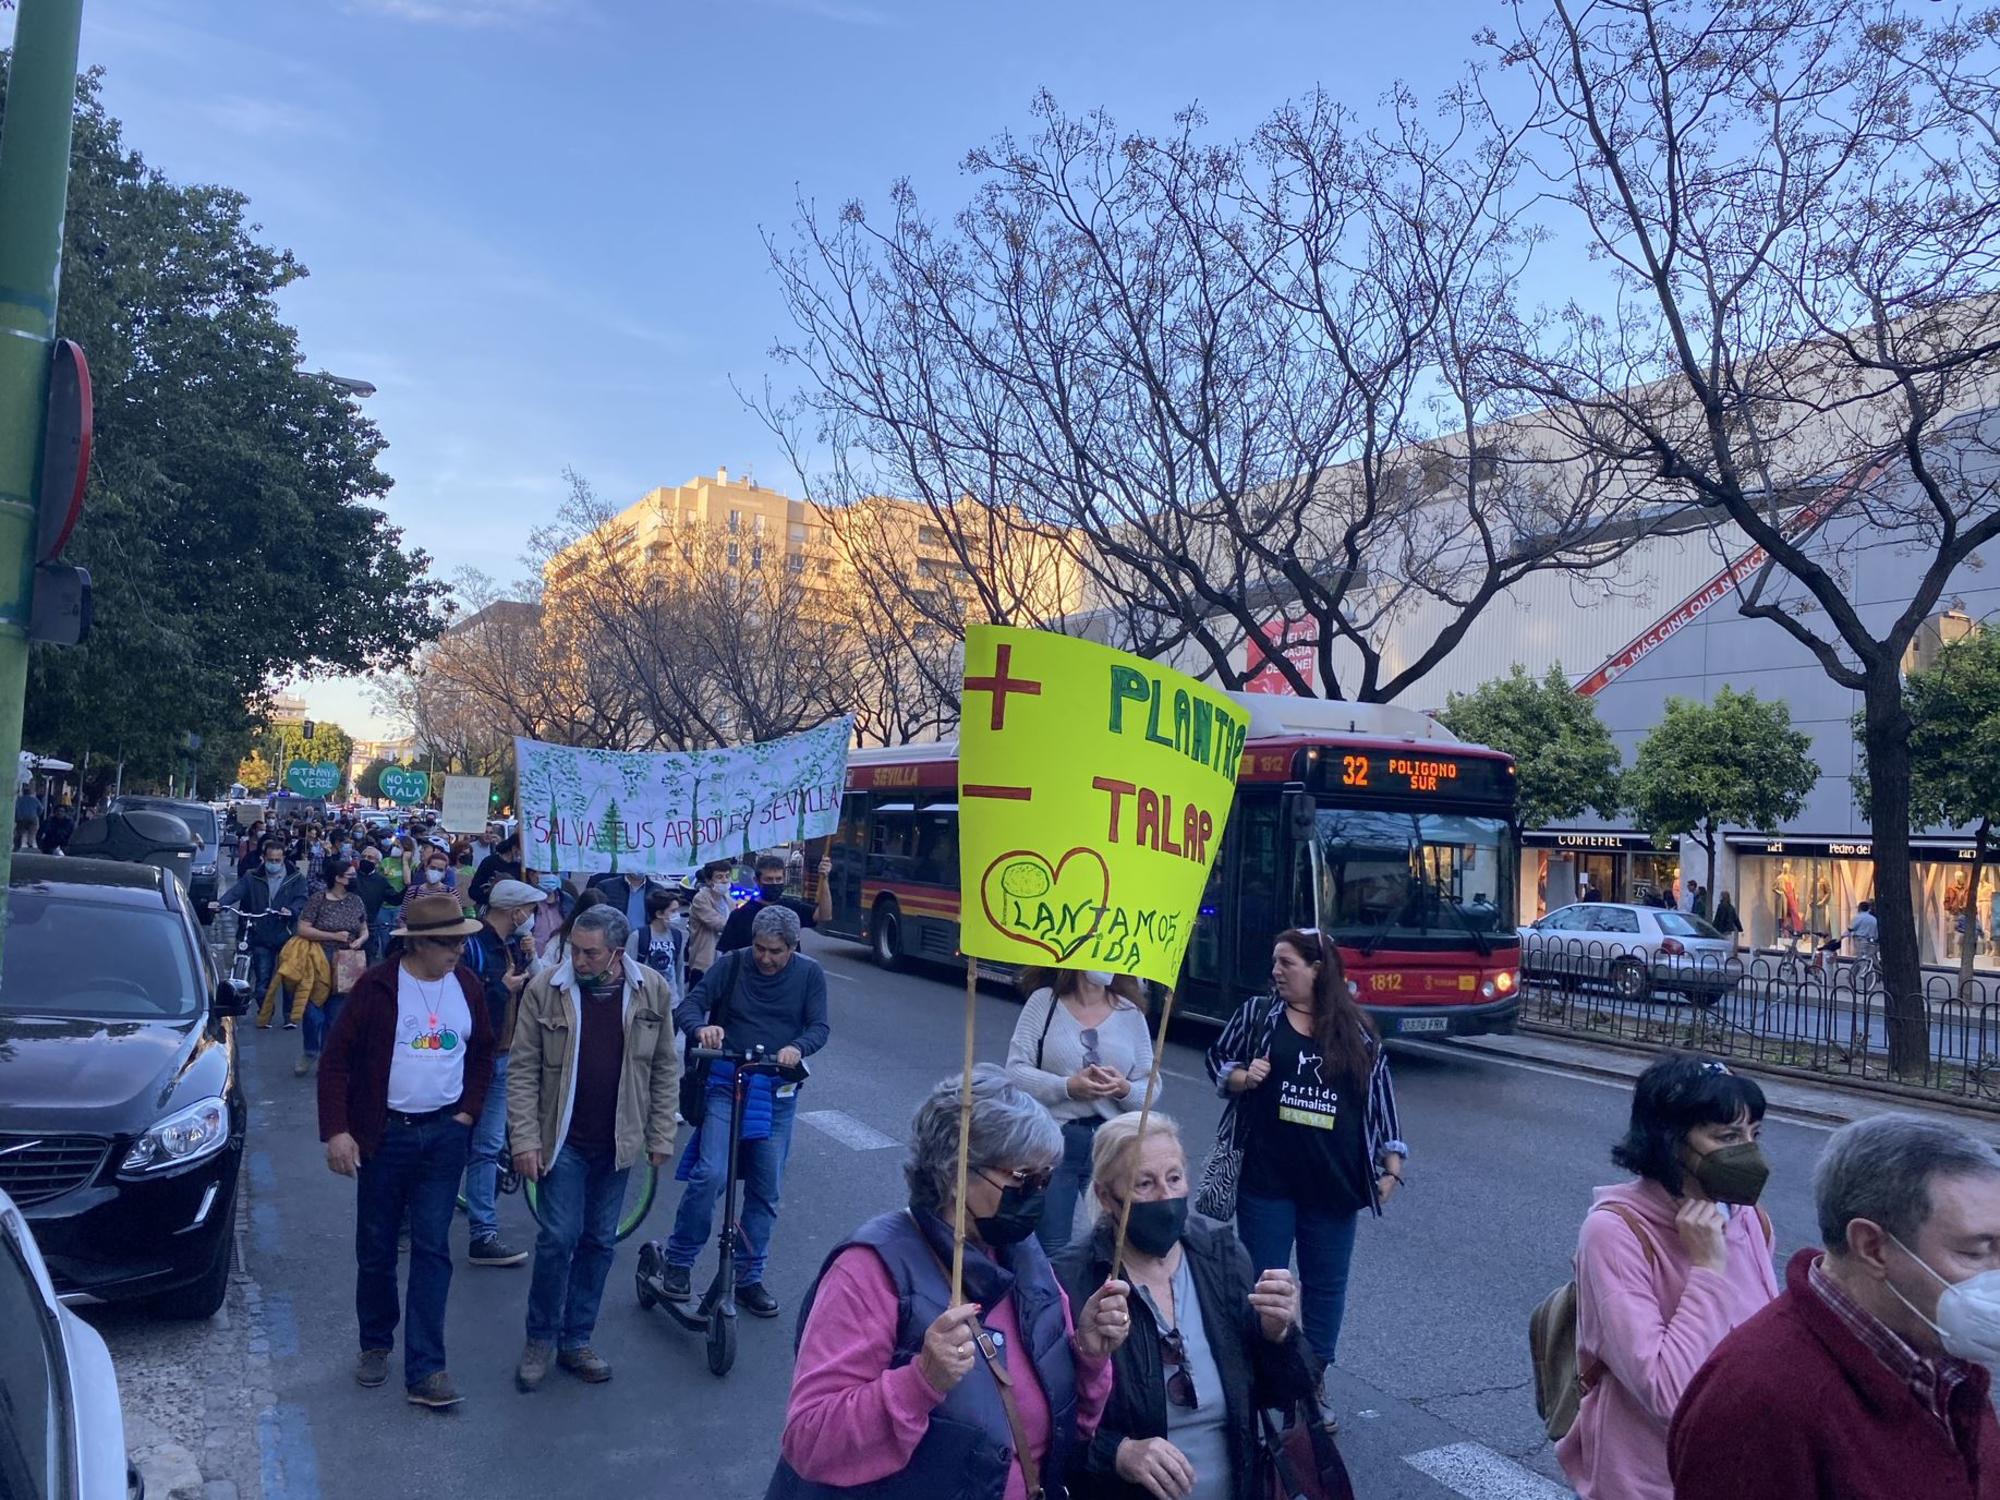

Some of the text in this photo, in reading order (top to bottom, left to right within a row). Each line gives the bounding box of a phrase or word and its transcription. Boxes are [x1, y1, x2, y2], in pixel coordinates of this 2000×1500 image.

[1629, 635, 1659, 664] MÁS
[1658, 613, 1690, 640] CINE
[1690, 588, 1720, 616] QUE
[1108, 664, 1247, 786] PLANTAR
[386, 774, 401, 785] NO
[873, 767, 919, 786] SEVILLA
[1342, 756, 1457, 785] 32 POLIGONO
[299, 777, 333, 788] VERDE
[386, 786, 421, 797] TALA
[1410, 776, 1437, 790] SUR
[534, 814, 600, 849] SALVA
[605, 819, 656, 849] TUS
[760, 784, 839, 825] SEVILLA
[1092, 776, 1213, 866] TALAR
[1557, 835, 1623, 847] CORTEFIEL
[1829, 843, 1855, 855] Pedro
[649, 941, 676, 951] NASA
[1369, 974, 1403, 991] 1812
[1281, 1081, 1338, 1101] Partido
[1280, 1094, 1337, 1114] Animalista
